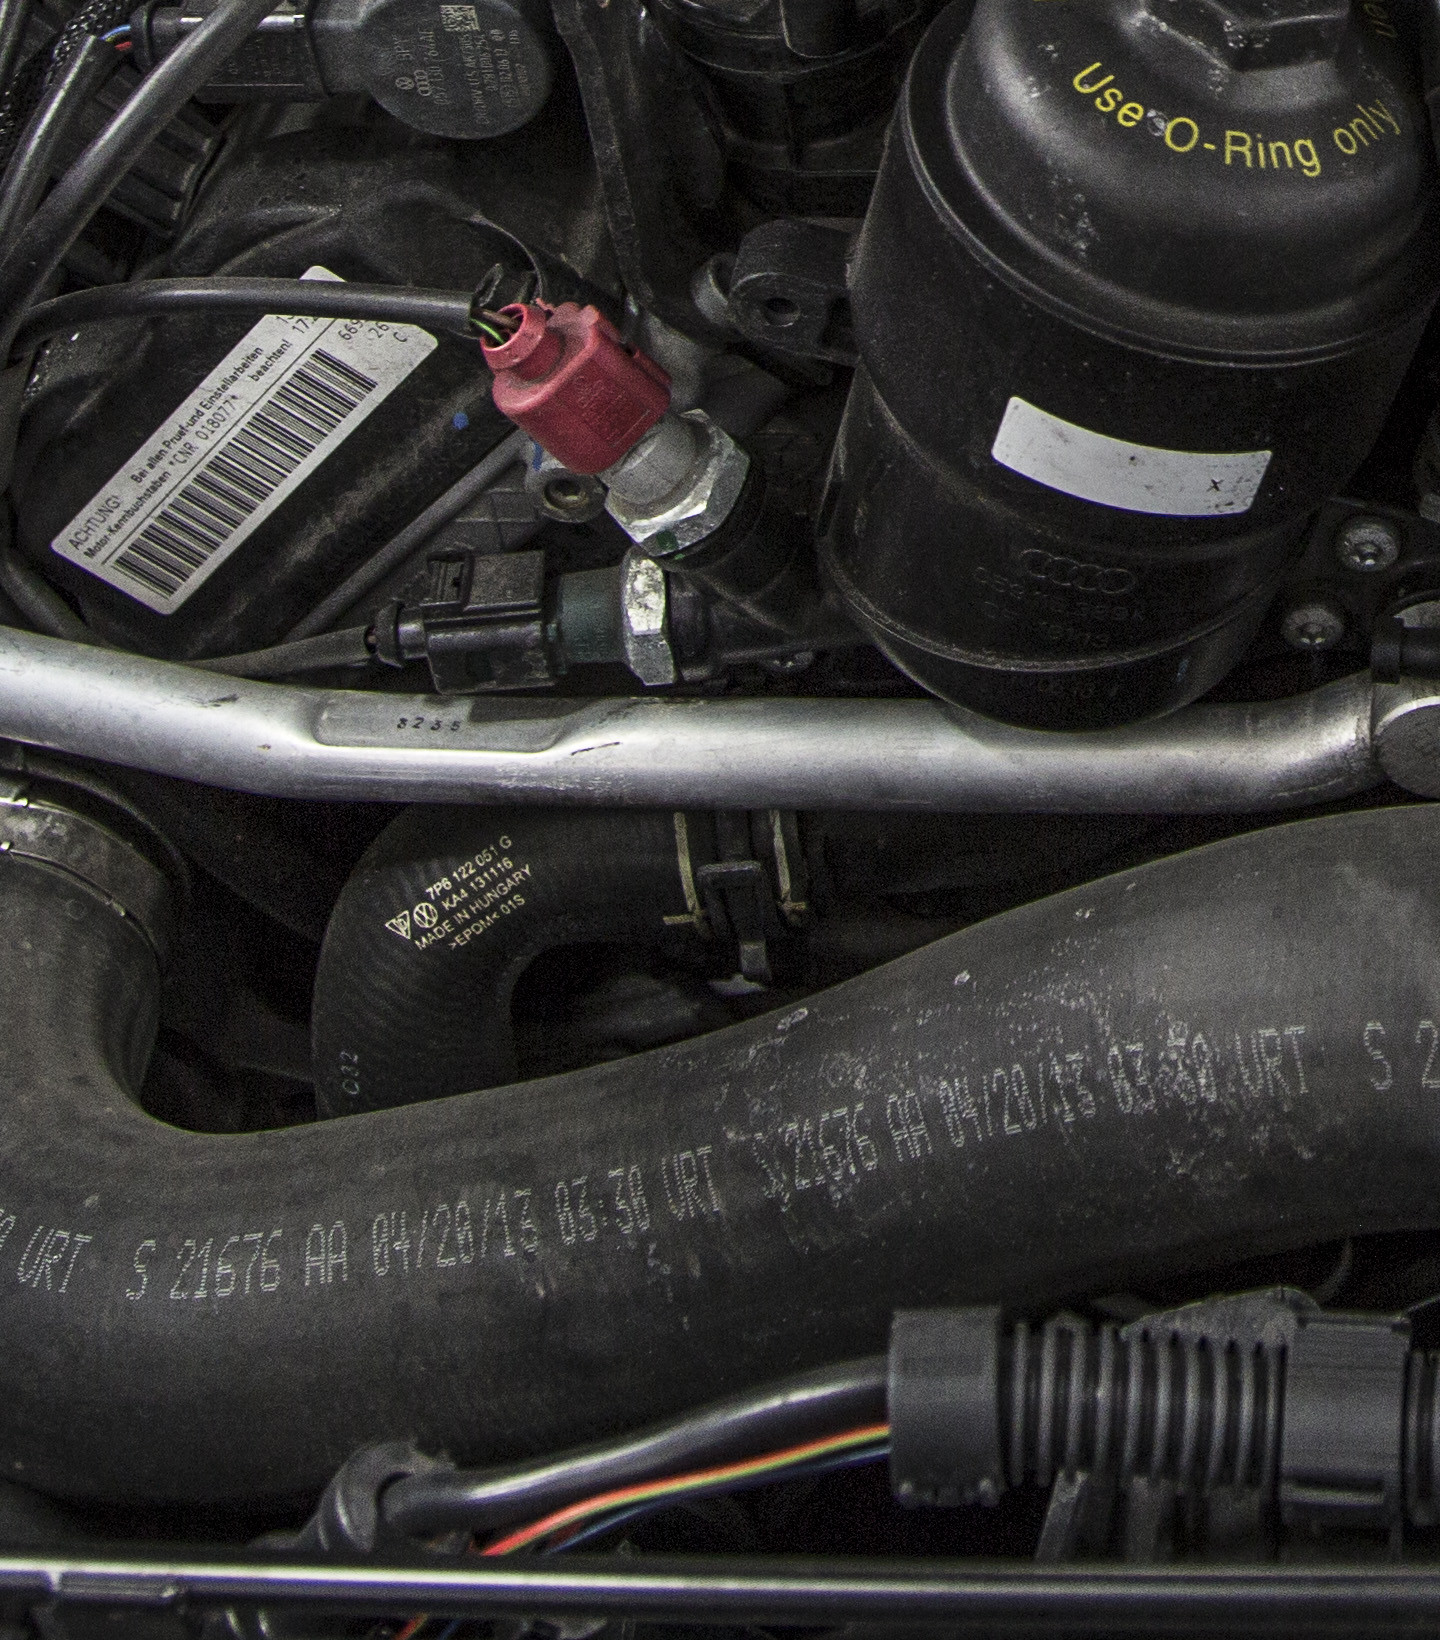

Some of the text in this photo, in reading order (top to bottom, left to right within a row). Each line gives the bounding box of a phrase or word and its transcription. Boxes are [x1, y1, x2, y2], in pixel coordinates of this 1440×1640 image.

[1072, 62, 1402, 177] Use O-Ring only
[250, 339, 294, 384] beachten!
[68, 496, 122, 551] ACHTUNG!
[131, 465, 150, 485] Bei
[146, 443, 170, 470] allen
[201, 346, 265, 412] Einstellarbeiten
[441, 888, 469, 911] KA4
[469, 857, 514, 892] 131116
[452, 861, 477, 883] 122
[474, 843, 499, 867] 051
[498, 835, 512, 849] G
[414, 863, 533, 951] MADE IN HUNGARY
[125, 1239, 157, 1302] S
[169, 1228, 284, 1301] 21676
[304, 1220, 350, 1289] AA
[886, 1090, 934, 1163] AA
[1363, 1019, 1395, 1091] S
